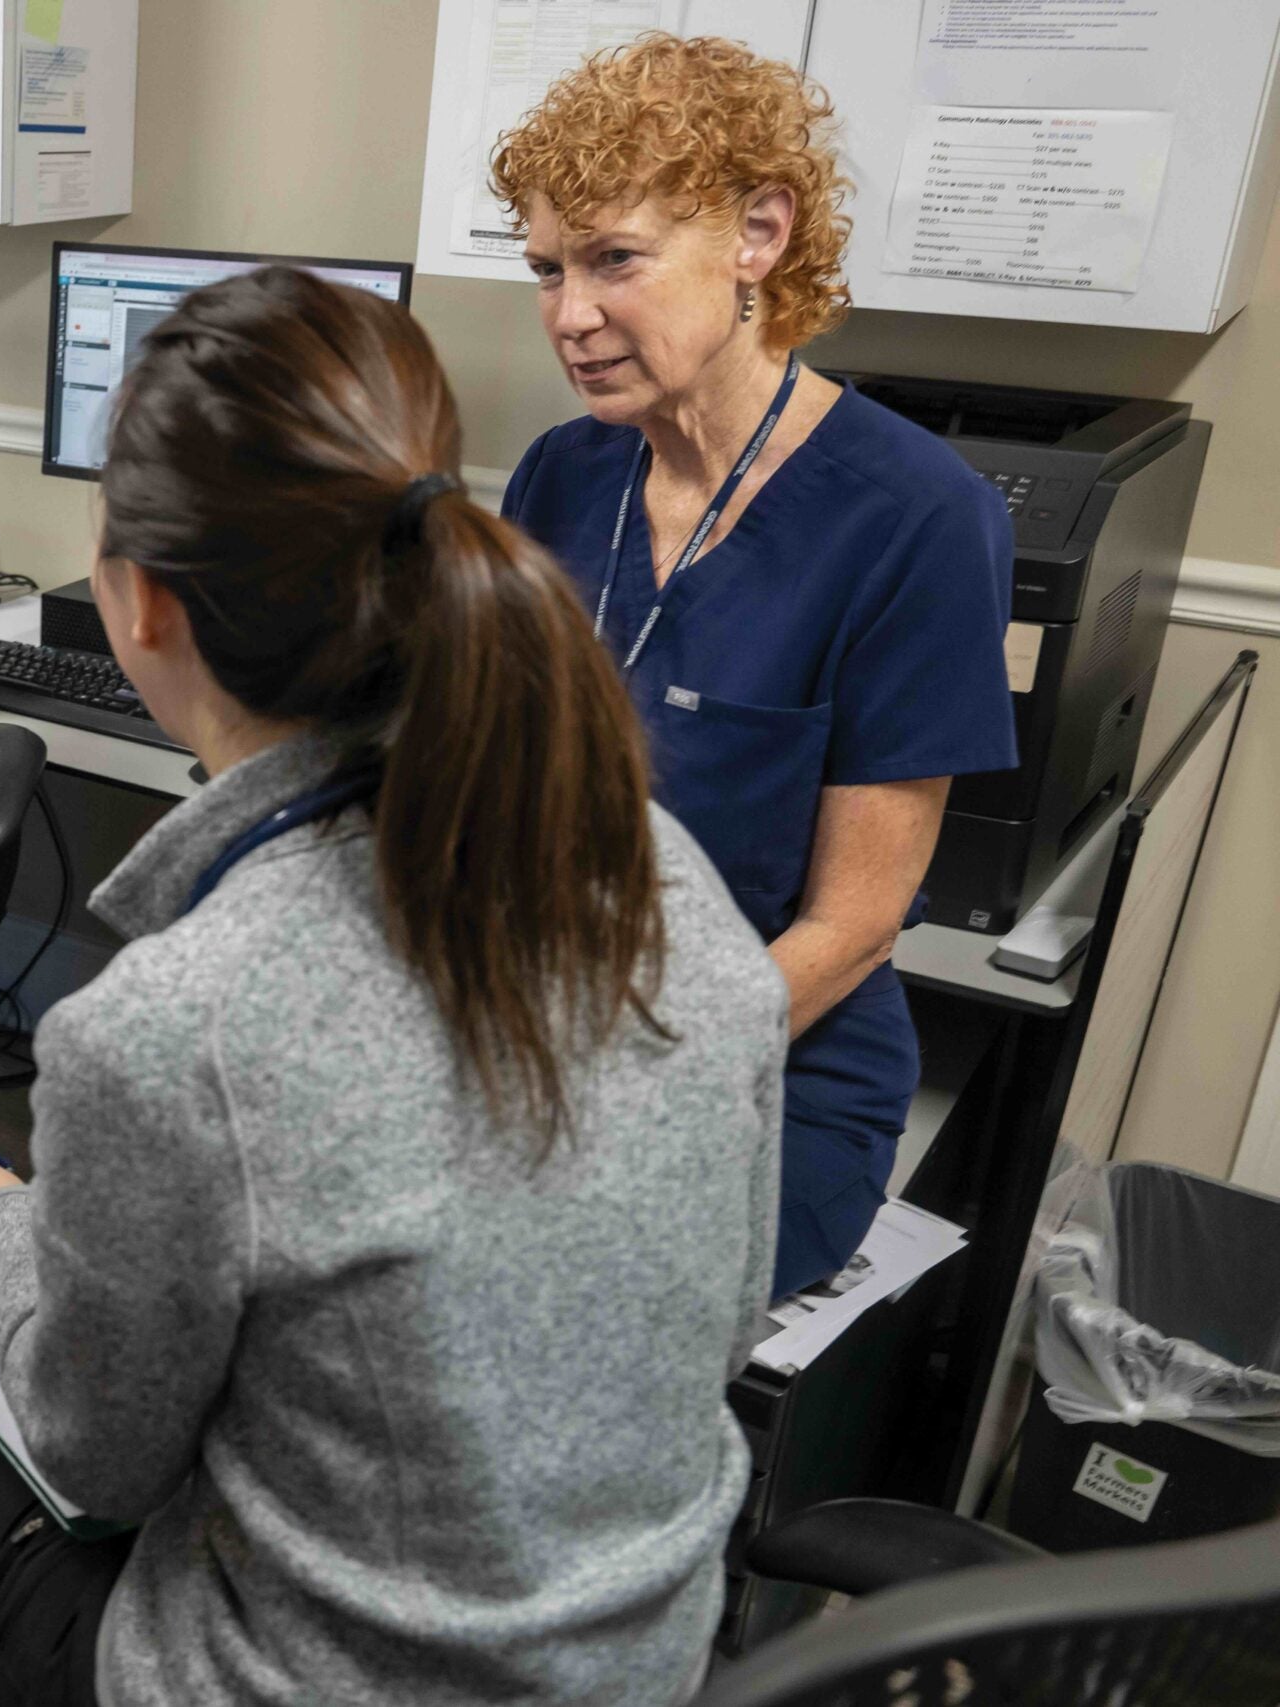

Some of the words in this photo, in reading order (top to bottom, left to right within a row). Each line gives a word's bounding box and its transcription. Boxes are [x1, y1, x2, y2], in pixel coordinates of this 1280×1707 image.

[733, 414, 778, 477] GEORGETOWN
[611, 484, 632, 550] GEORGETOWN
[674, 509, 718, 573] GEORGETOWN
[623, 605, 662, 668] GEORGETOWN
[1087, 1467, 1150, 1501] Farmers
[1094, 1450, 1109, 1467] I
[1082, 1478, 1145, 1512] Markets
